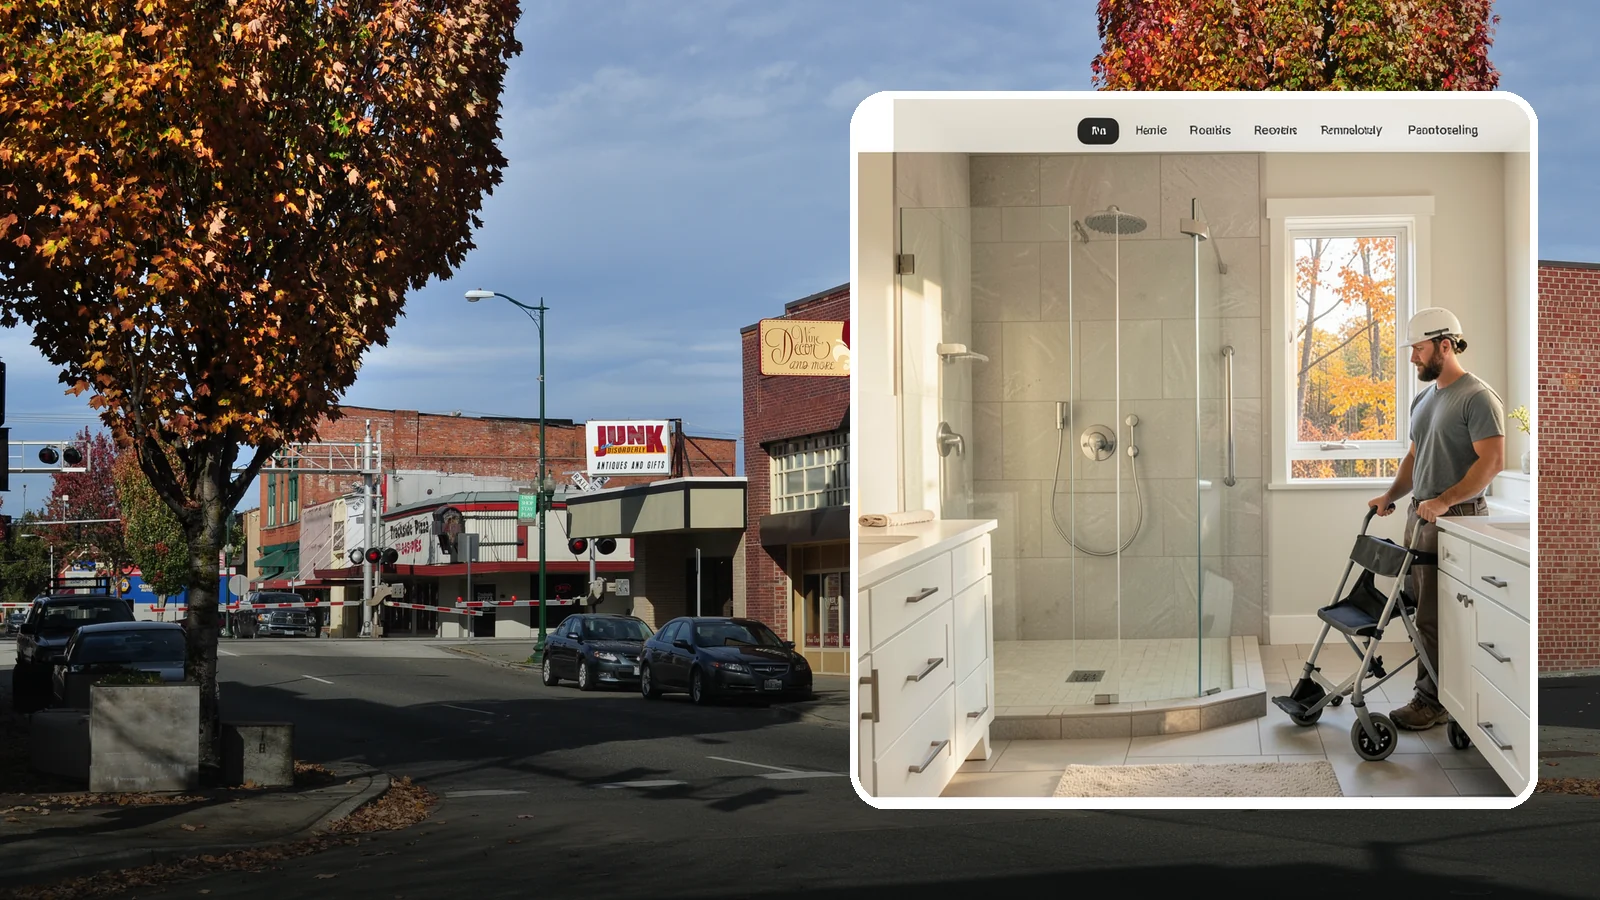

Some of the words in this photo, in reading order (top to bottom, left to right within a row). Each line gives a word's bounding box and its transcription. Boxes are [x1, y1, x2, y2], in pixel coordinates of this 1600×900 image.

[595, 425, 665, 457] JUNK
[597, 461, 628, 470] ANTIQUES
[631, 461, 644, 470] AND
[647, 460, 665, 470] GIFTS
[415, 520, 429, 534] Pizza
